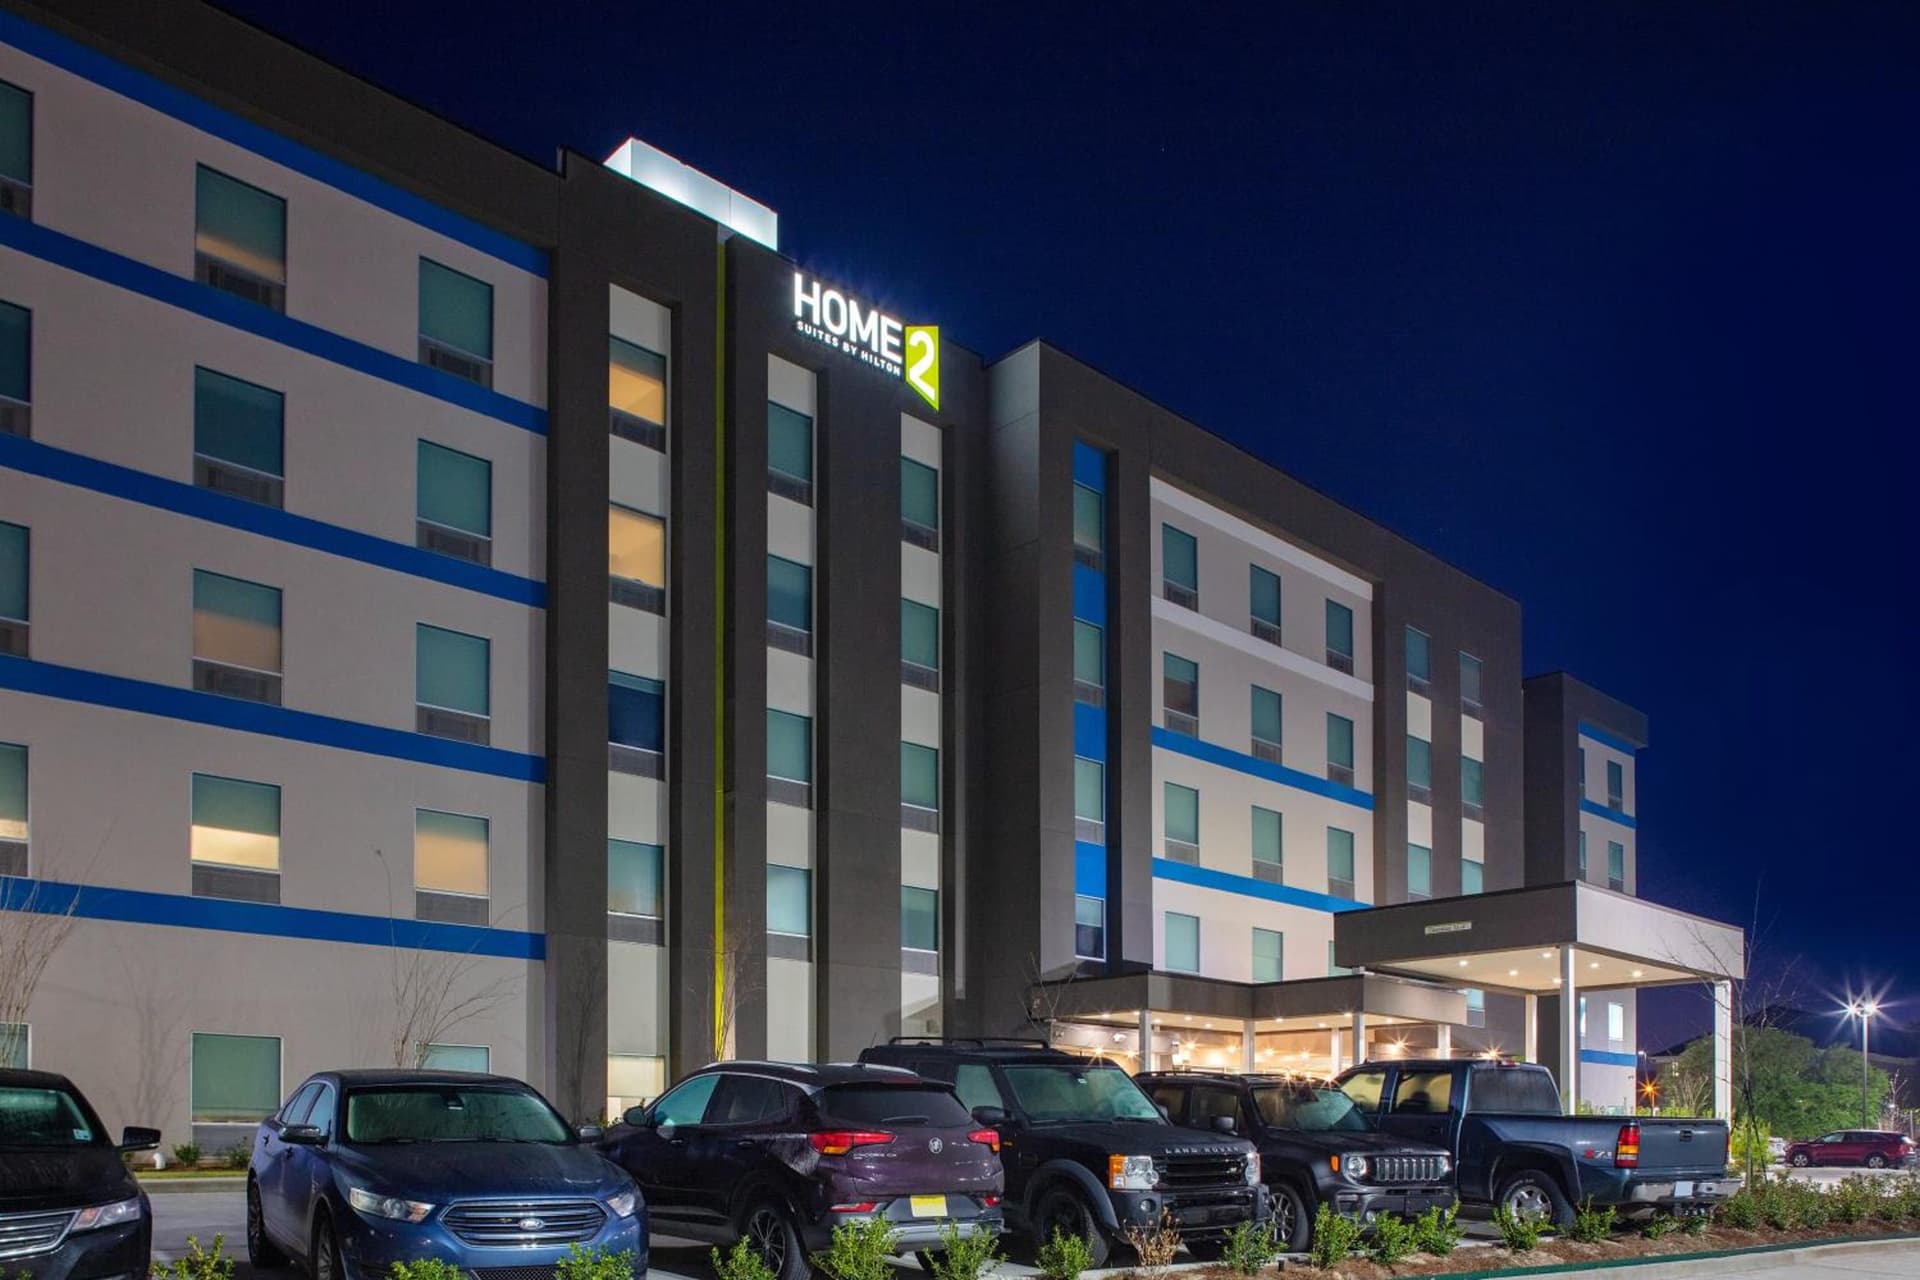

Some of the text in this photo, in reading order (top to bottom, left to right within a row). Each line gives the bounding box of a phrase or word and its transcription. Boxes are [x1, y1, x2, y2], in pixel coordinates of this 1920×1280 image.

[794, 272, 936, 401] HOME 2
[797, 321, 901, 377] SUITES BY HILTON
